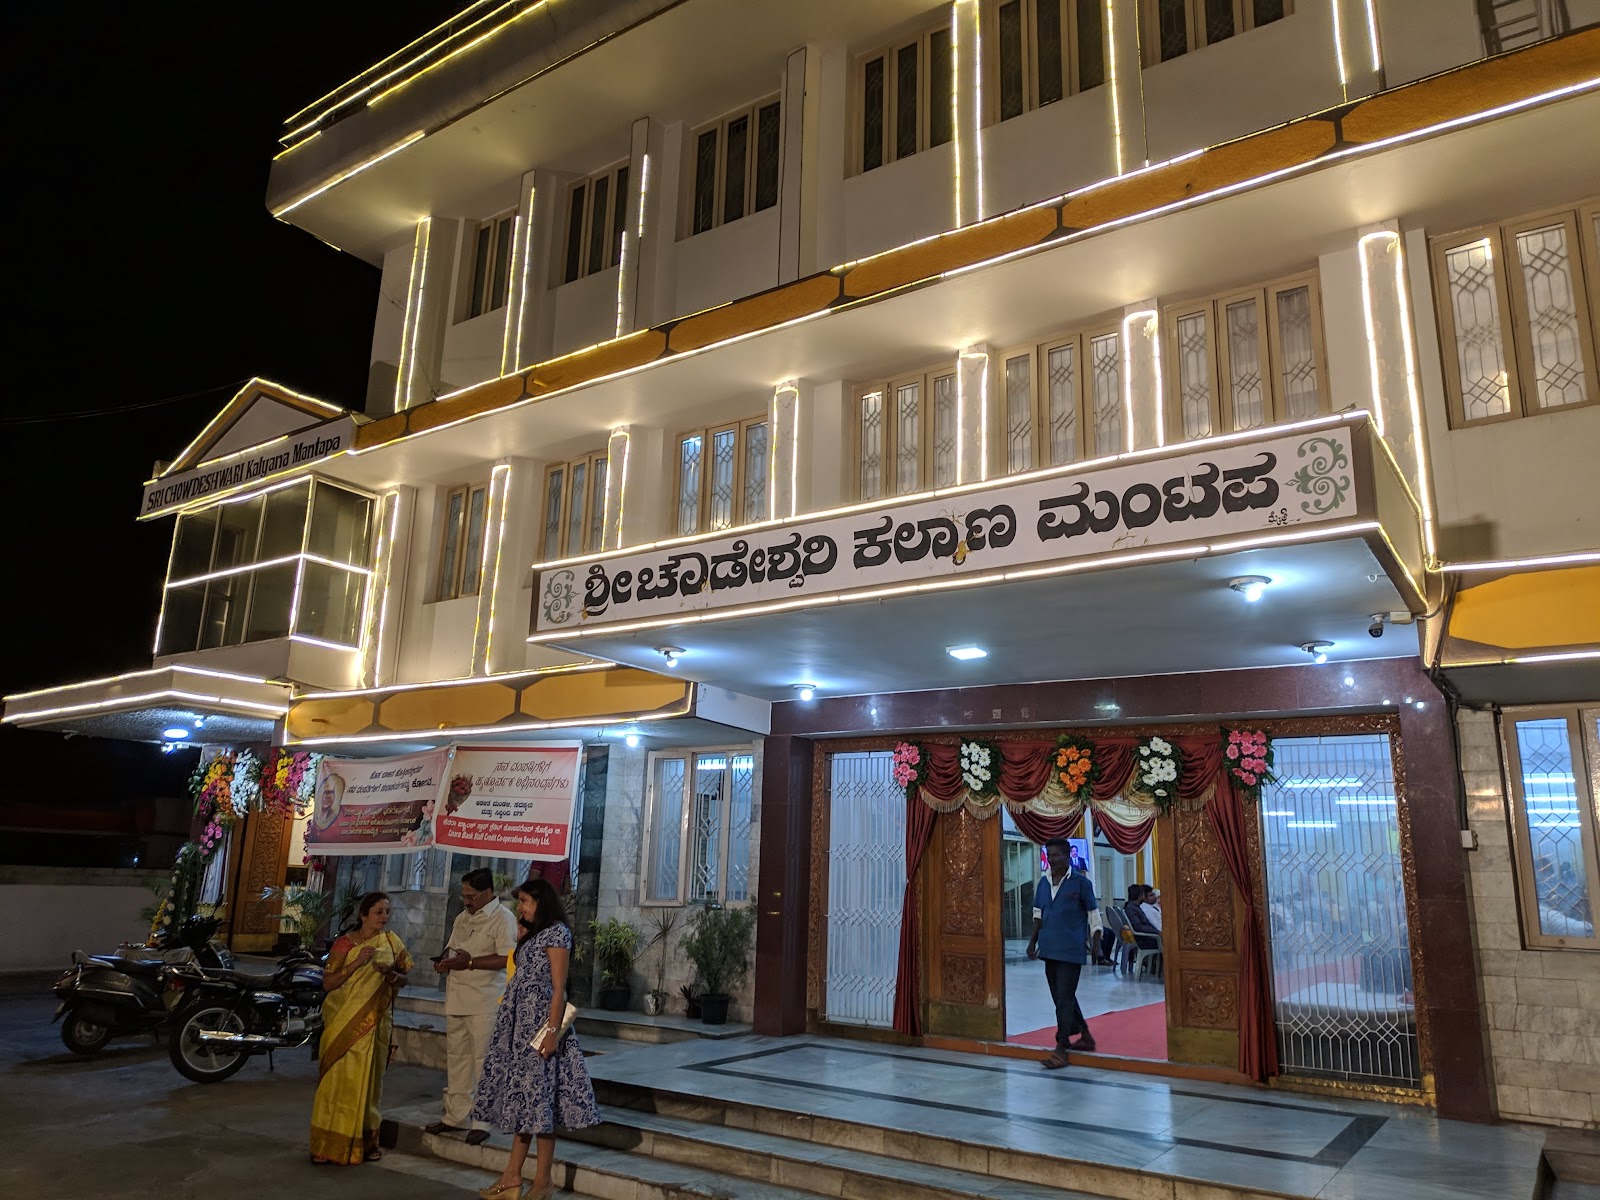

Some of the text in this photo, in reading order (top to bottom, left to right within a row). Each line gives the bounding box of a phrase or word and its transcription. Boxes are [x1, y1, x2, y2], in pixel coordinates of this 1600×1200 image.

[148, 490, 165, 510] SRI
[246, 453, 290, 480] Kalyana
[292, 436, 340, 463] Mantapa
[852, 504, 1017, 570] ಕಲ್ಯಾಣ
[1037, 451, 1280, 542] ಮಂಟಪ
[461, 831, 474, 840] Bank
[473, 832, 485, 841] Staff
[484, 832, 498, 842] Credit
[523, 836, 541, 847] Society
